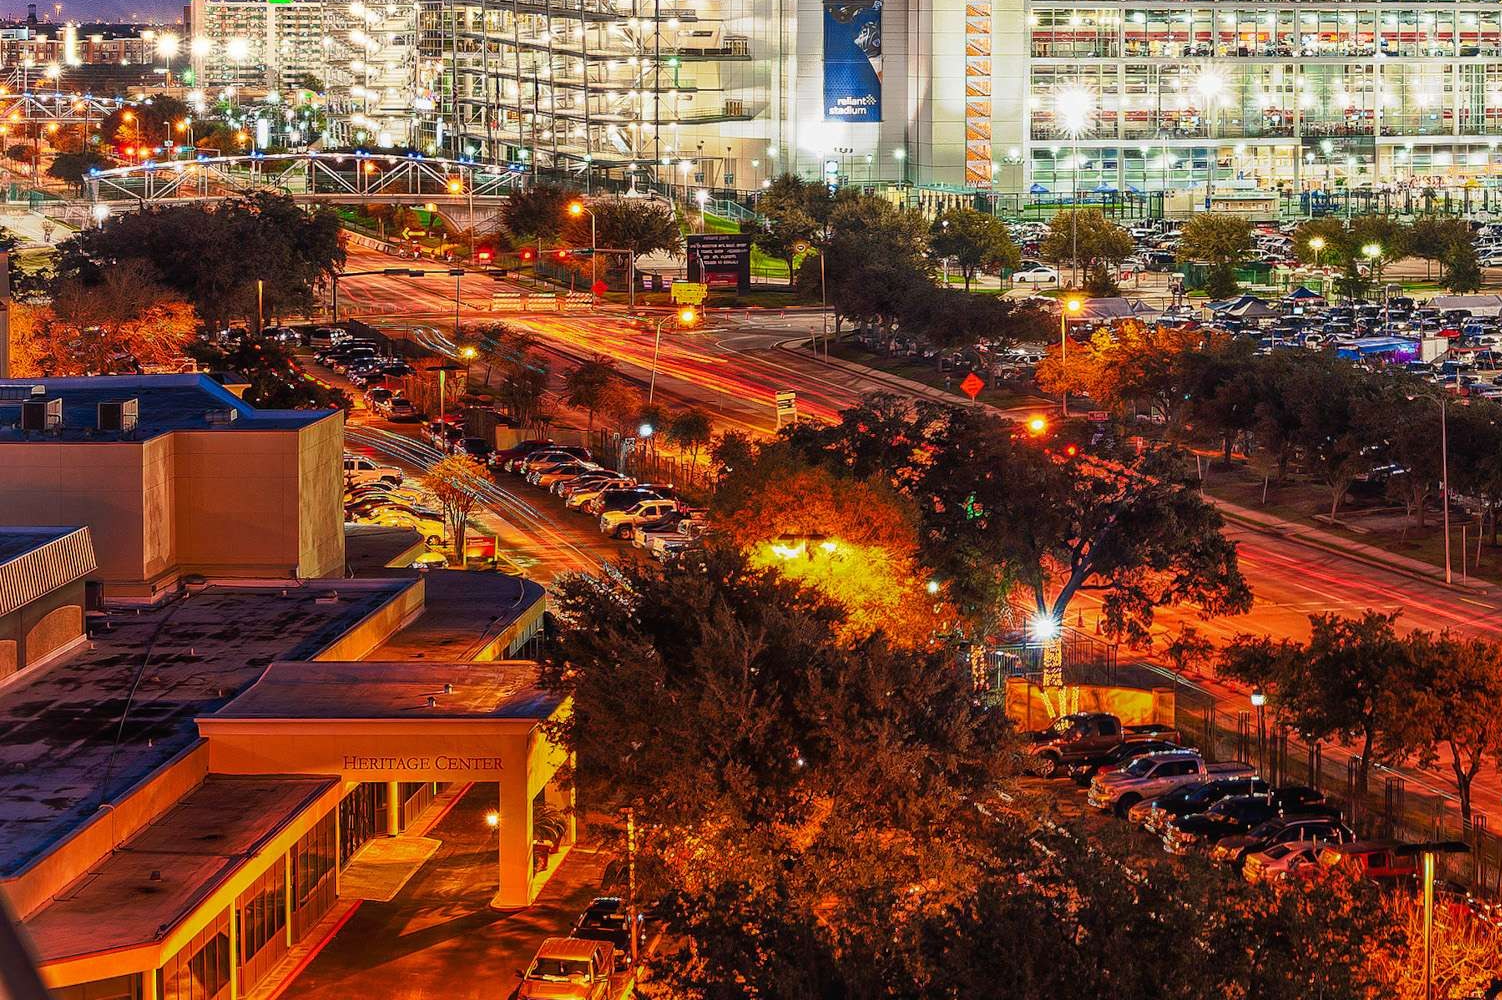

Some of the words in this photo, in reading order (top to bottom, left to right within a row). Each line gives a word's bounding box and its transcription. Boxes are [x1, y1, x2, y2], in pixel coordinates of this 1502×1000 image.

[837, 96, 866, 105] reliant
[829, 106, 867, 115] stadium
[343, 755, 430, 770] HERITAGE
[435, 755, 504, 770] CENTER
